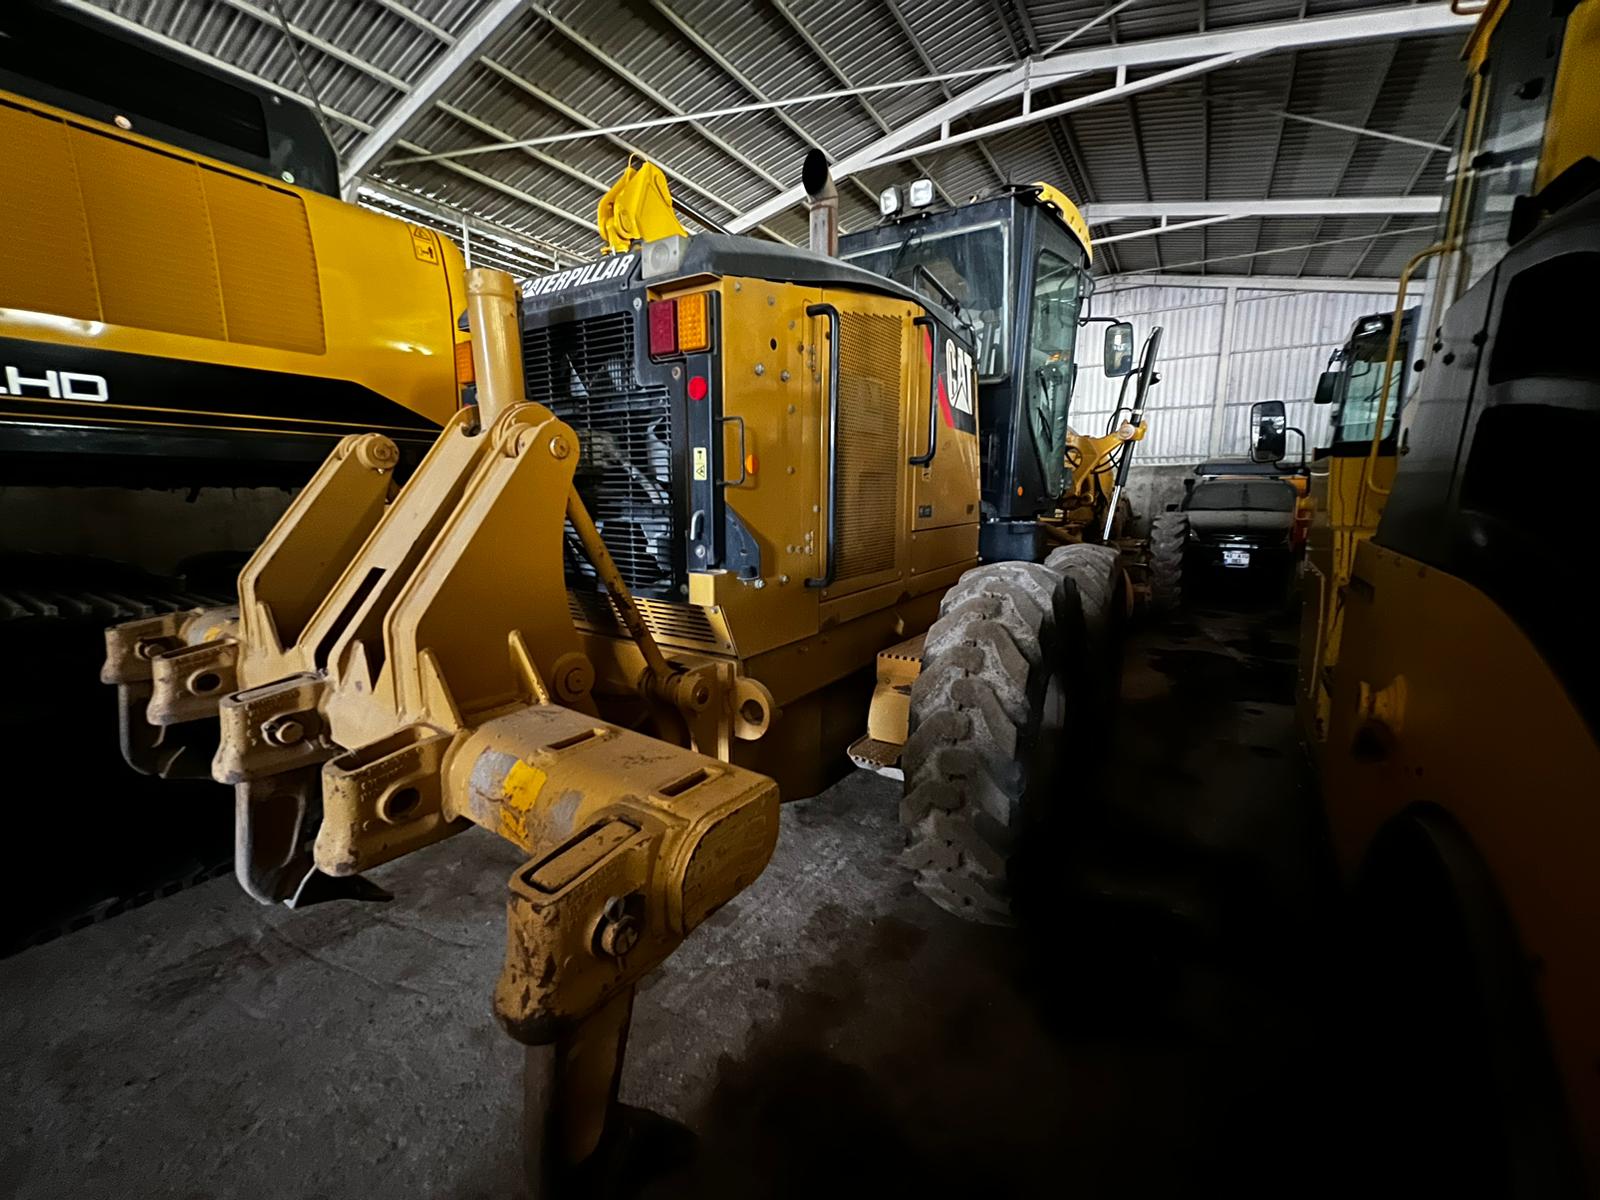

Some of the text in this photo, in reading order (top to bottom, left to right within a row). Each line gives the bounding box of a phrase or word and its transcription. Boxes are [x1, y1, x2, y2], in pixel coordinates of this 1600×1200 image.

[521, 254, 635, 299] CATERPILLAR
[0, 366, 108, 402] HD
[945, 338, 973, 415] CAT
